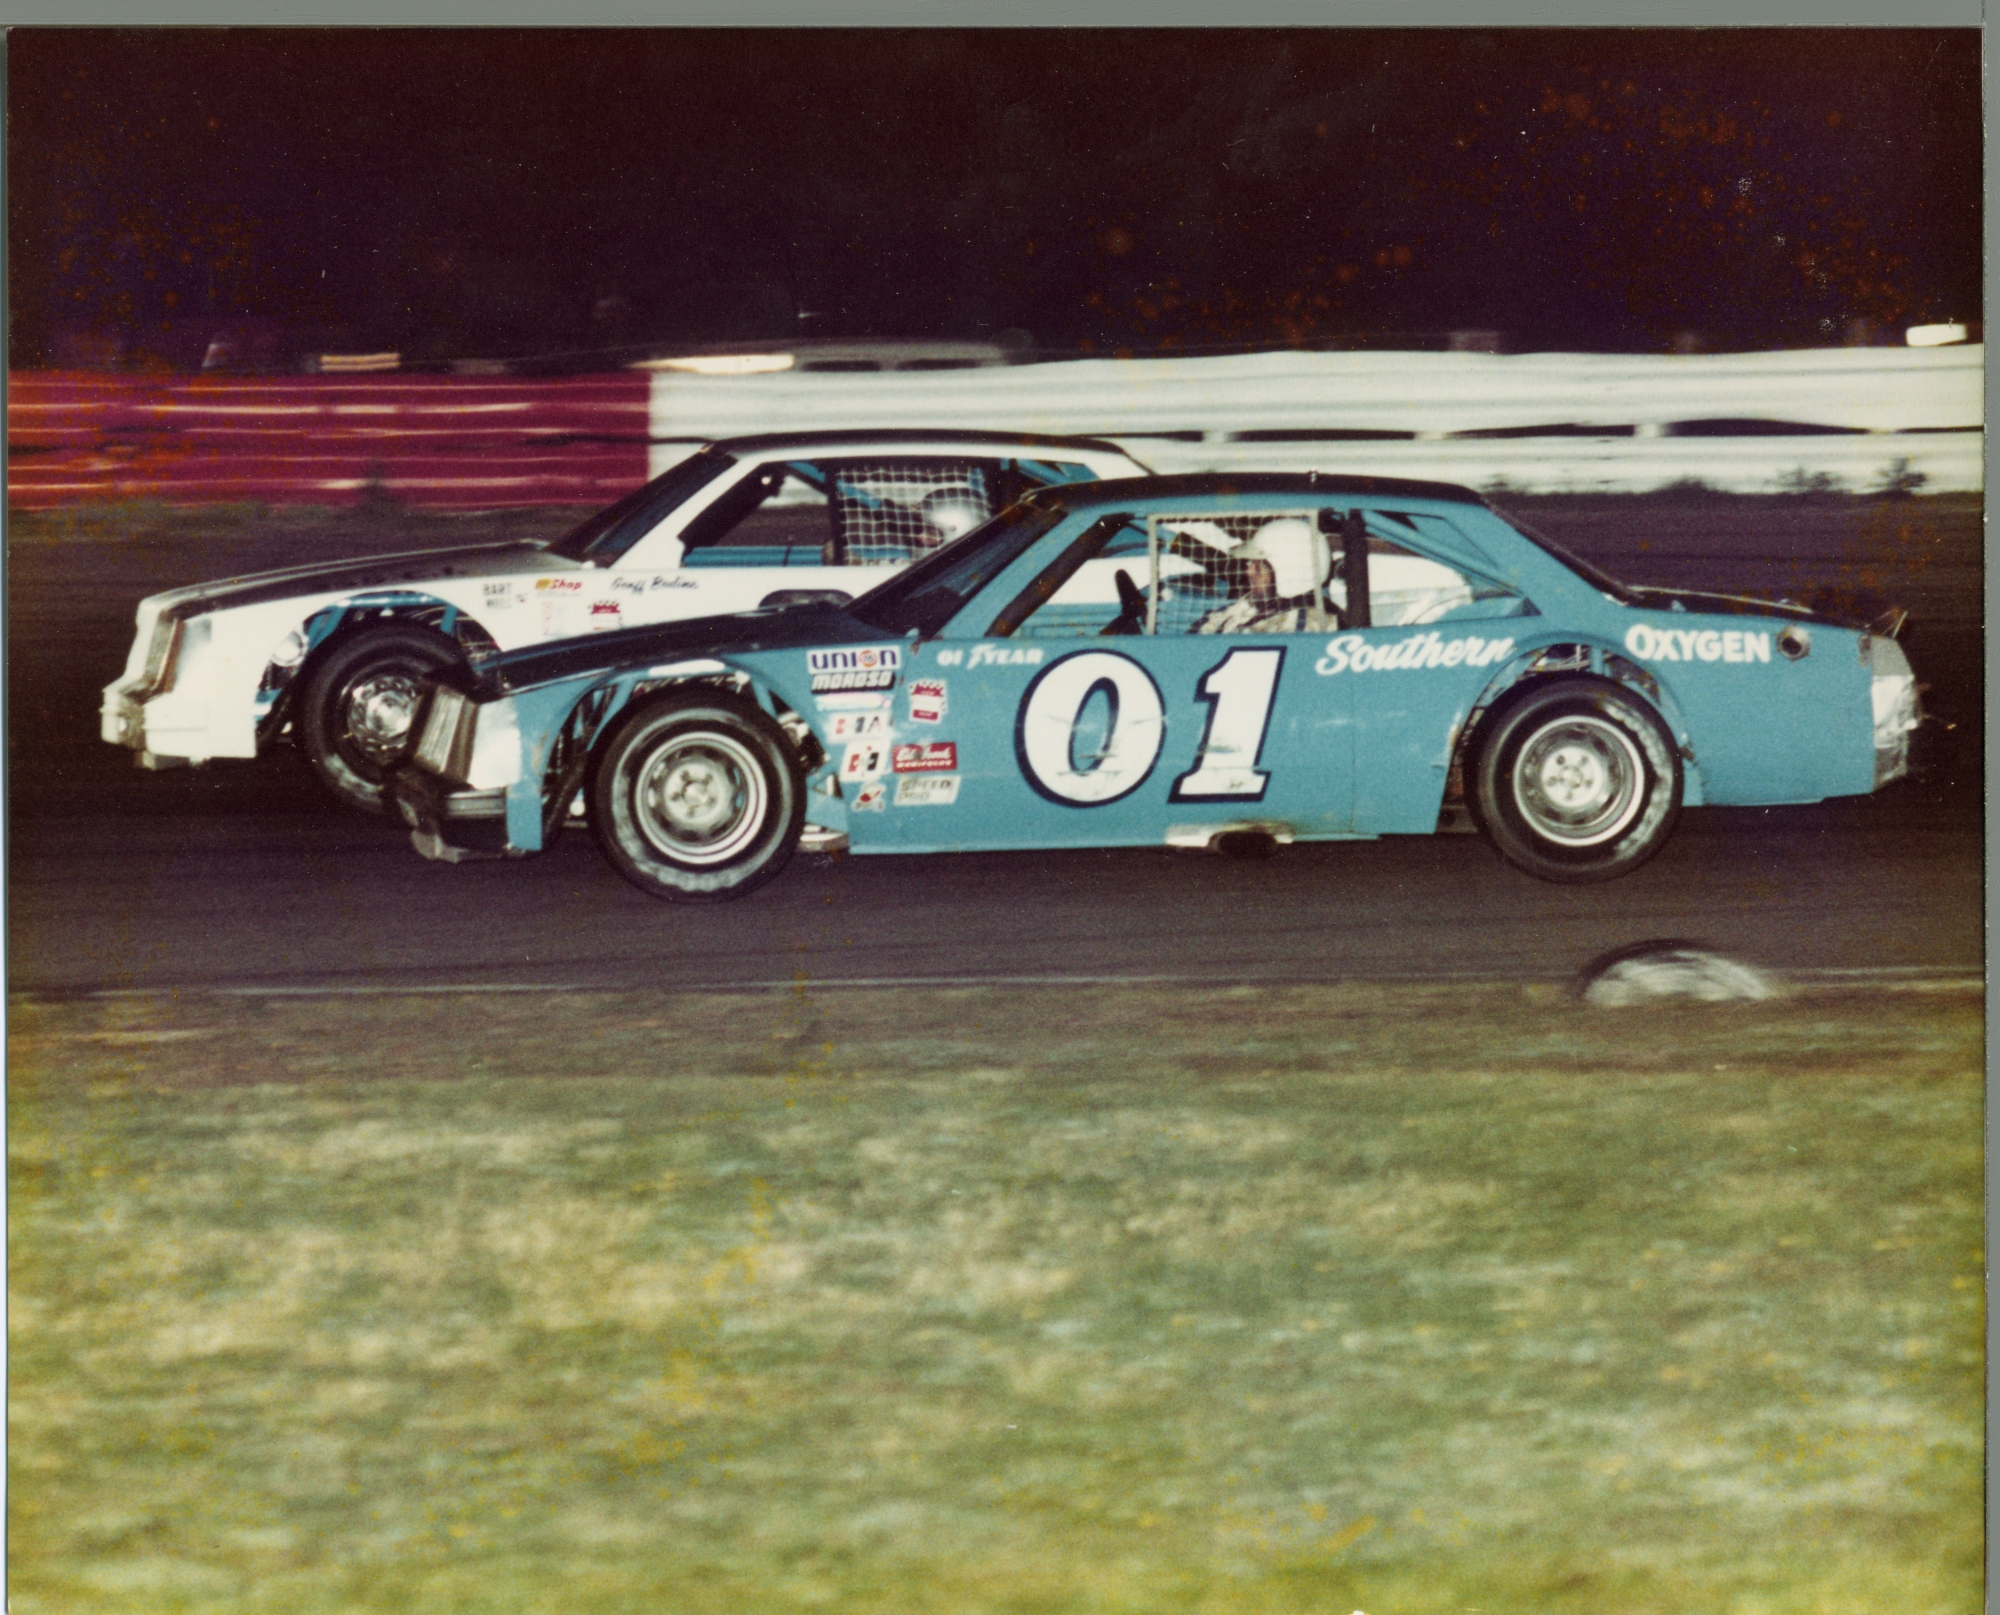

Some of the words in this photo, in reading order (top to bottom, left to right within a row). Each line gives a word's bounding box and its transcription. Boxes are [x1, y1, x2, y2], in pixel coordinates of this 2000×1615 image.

[1314, 633, 1517, 676] Southern
[1625, 623, 1770, 664] OXYGEN
[1014, 646, 1288, 809] 01
